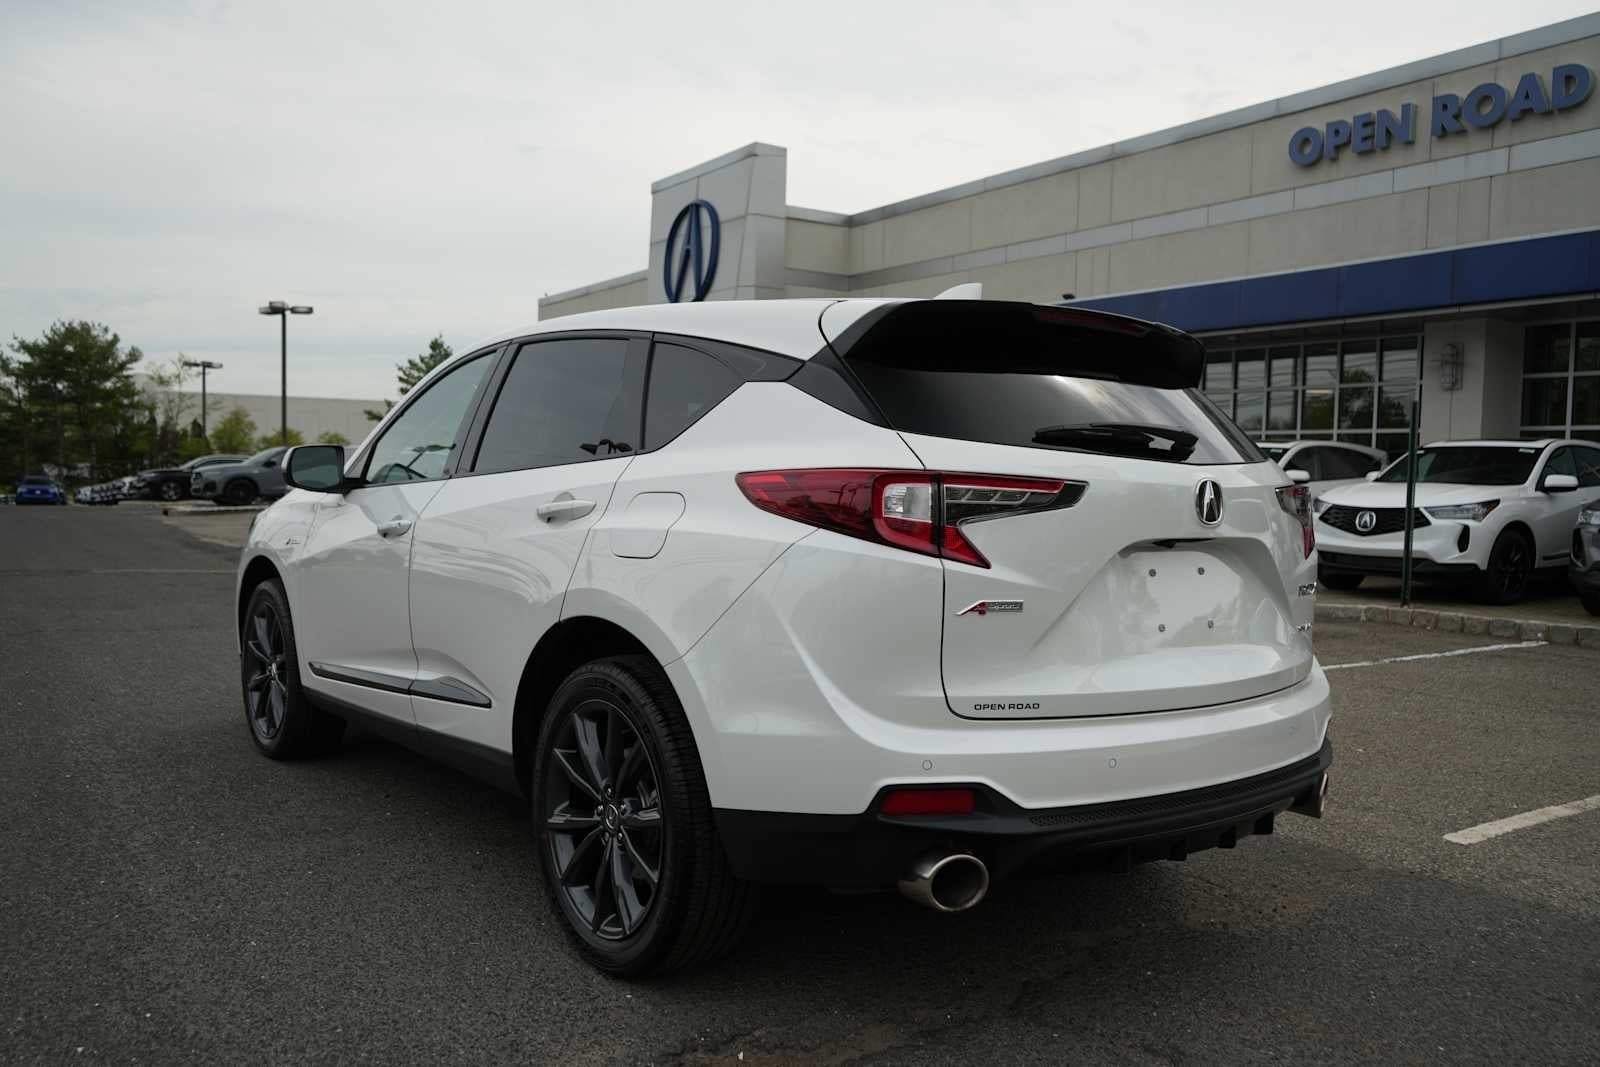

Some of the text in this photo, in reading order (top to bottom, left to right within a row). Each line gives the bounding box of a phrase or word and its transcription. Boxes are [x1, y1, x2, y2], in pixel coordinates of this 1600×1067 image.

[1289, 64, 1594, 166] OPEN ROAD
[974, 702, 1040, 711] OPEN ROAD
